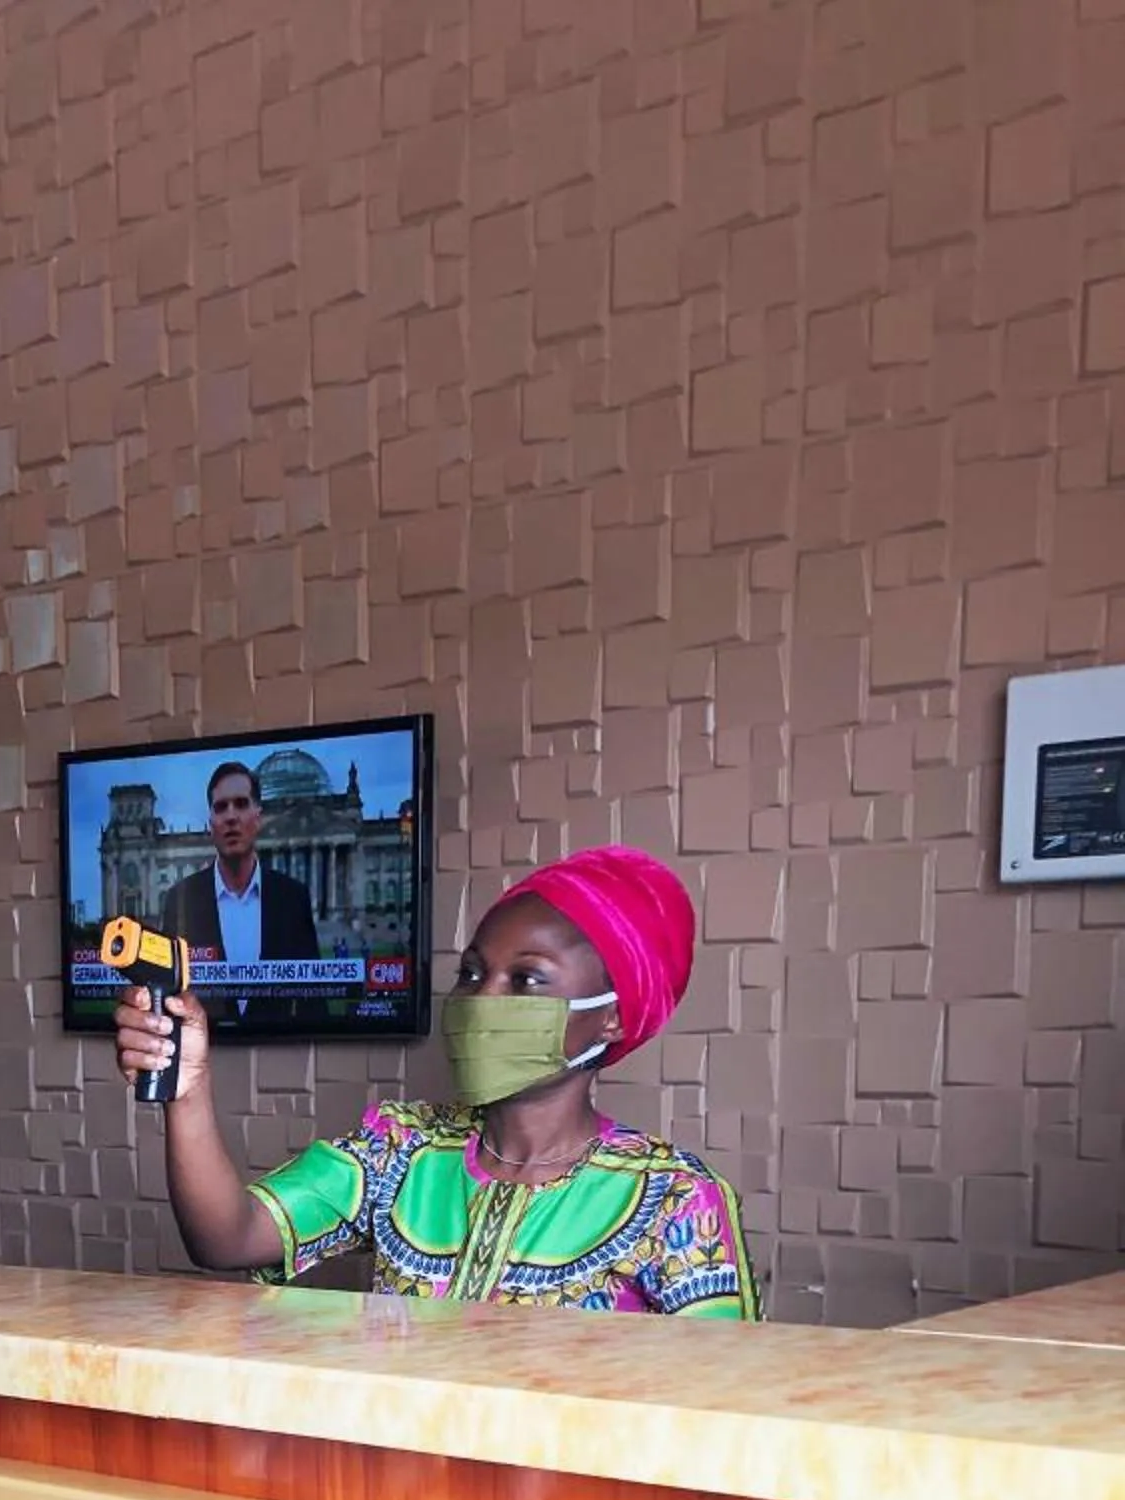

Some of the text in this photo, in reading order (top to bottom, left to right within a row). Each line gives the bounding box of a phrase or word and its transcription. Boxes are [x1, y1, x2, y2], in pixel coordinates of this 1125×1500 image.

[229, 964, 270, 981] WITHOUT
[271, 963, 295, 979] FANS
[297, 963, 309, 979] AT
[312, 962, 357, 979] MATCHES
[370, 963, 404, 983] CNN
